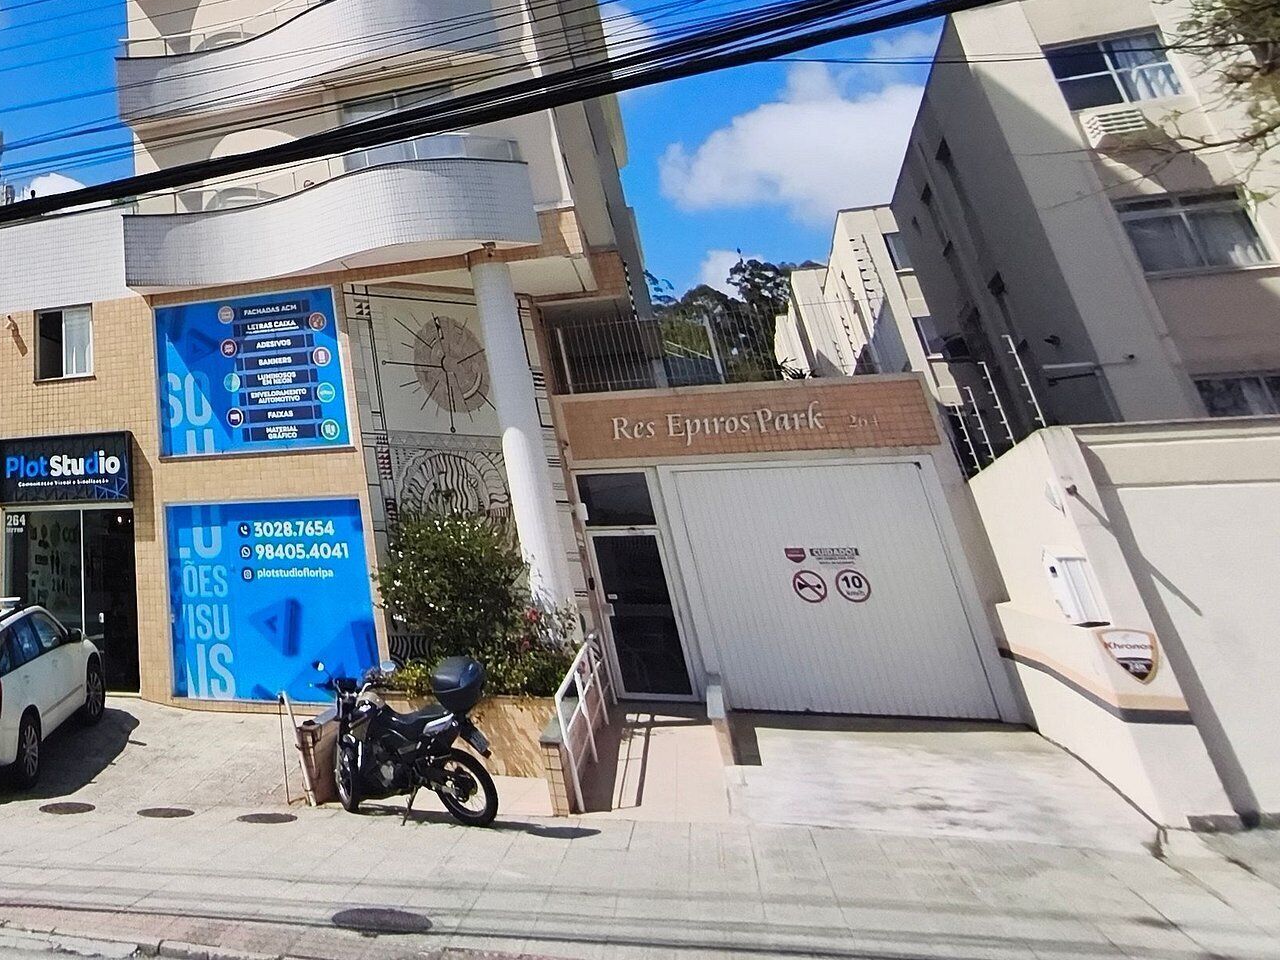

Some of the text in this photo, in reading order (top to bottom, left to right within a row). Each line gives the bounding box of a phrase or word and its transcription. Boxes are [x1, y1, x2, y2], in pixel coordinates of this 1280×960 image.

[244, 304, 297, 316] FACHADAS ACM
[247, 321, 273, 331] LETRAS
[273, 319, 297, 328] CAIXA
[256, 338, 292, 349] ADESIVOS
[258, 356, 292, 367] BANNERS
[257, 371, 297, 381] LUMINOSOS
[258, 395, 301, 404] AUTOMOTIVO
[267, 410, 294, 419] FAIXAS
[611, 416, 656, 441] Res
[665, 413, 751, 447] Epiros
[753, 400, 825, 434] Park
[265, 425, 298, 434] MATERIAL
[267, 430, 298, 439] GRÁFICO
[6, 514, 26, 526] 264
[253, 520, 335, 538] 3028.7654
[255, 542, 350, 560] 98405.4041
[812, 547, 856, 556] CUIDADO!
[257, 567, 334, 580] plotstudiofloripa
[841, 575, 863, 589] 10
